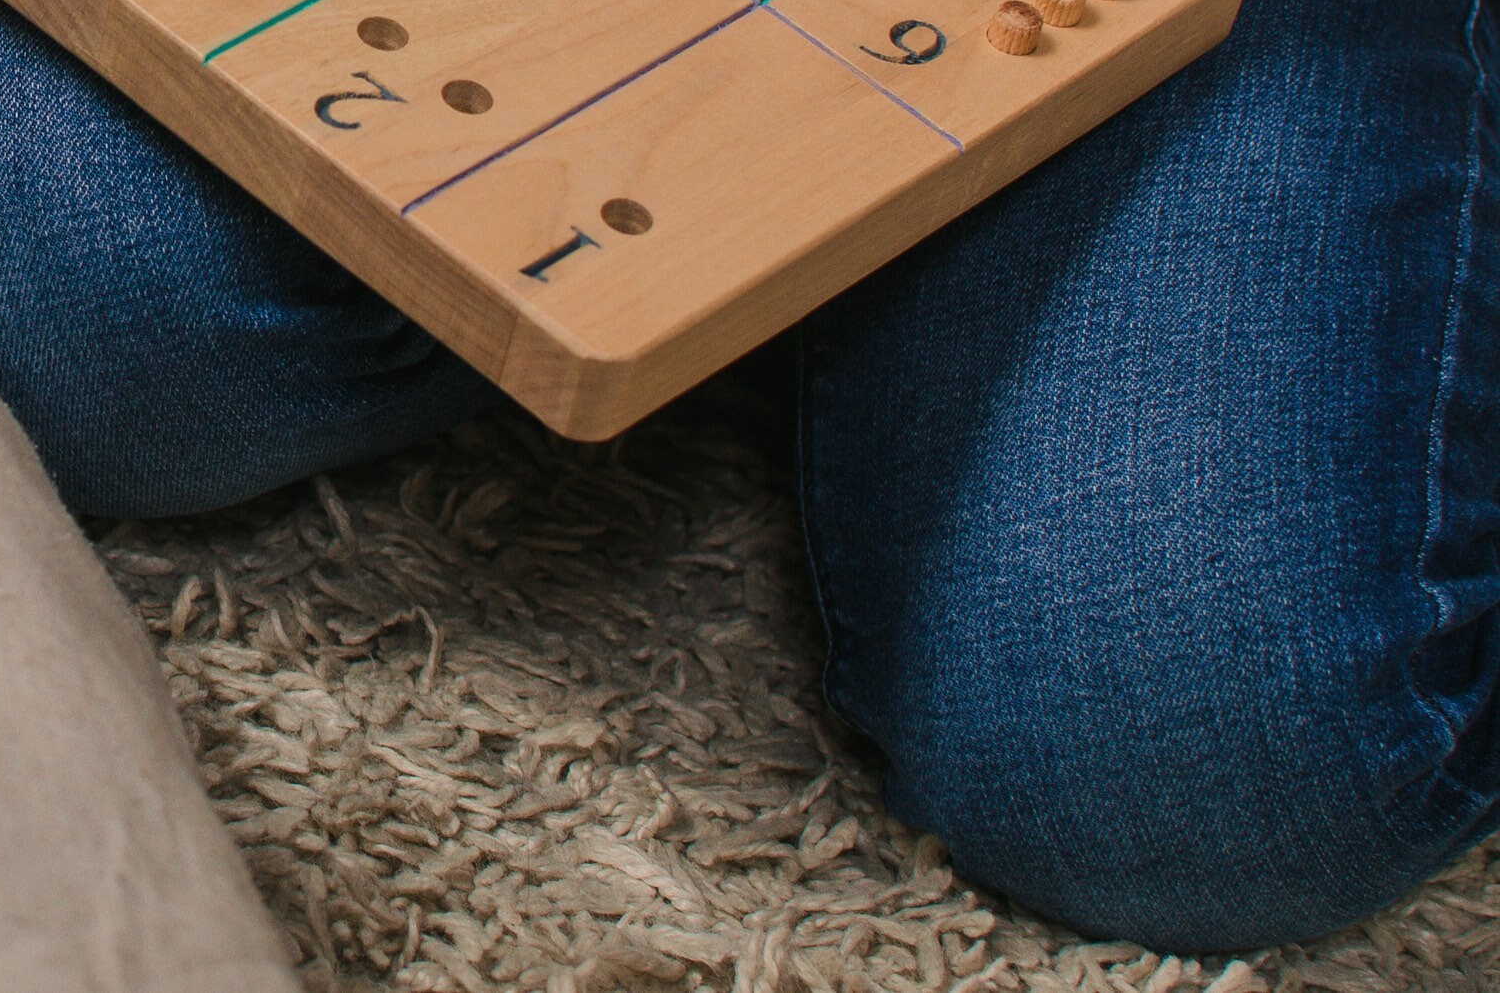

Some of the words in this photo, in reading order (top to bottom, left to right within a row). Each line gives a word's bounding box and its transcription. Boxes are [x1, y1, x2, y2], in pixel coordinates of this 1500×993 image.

[859, 19, 947, 66] 6
[314, 71, 409, 131] 2
[519, 225, 602, 284] 1
